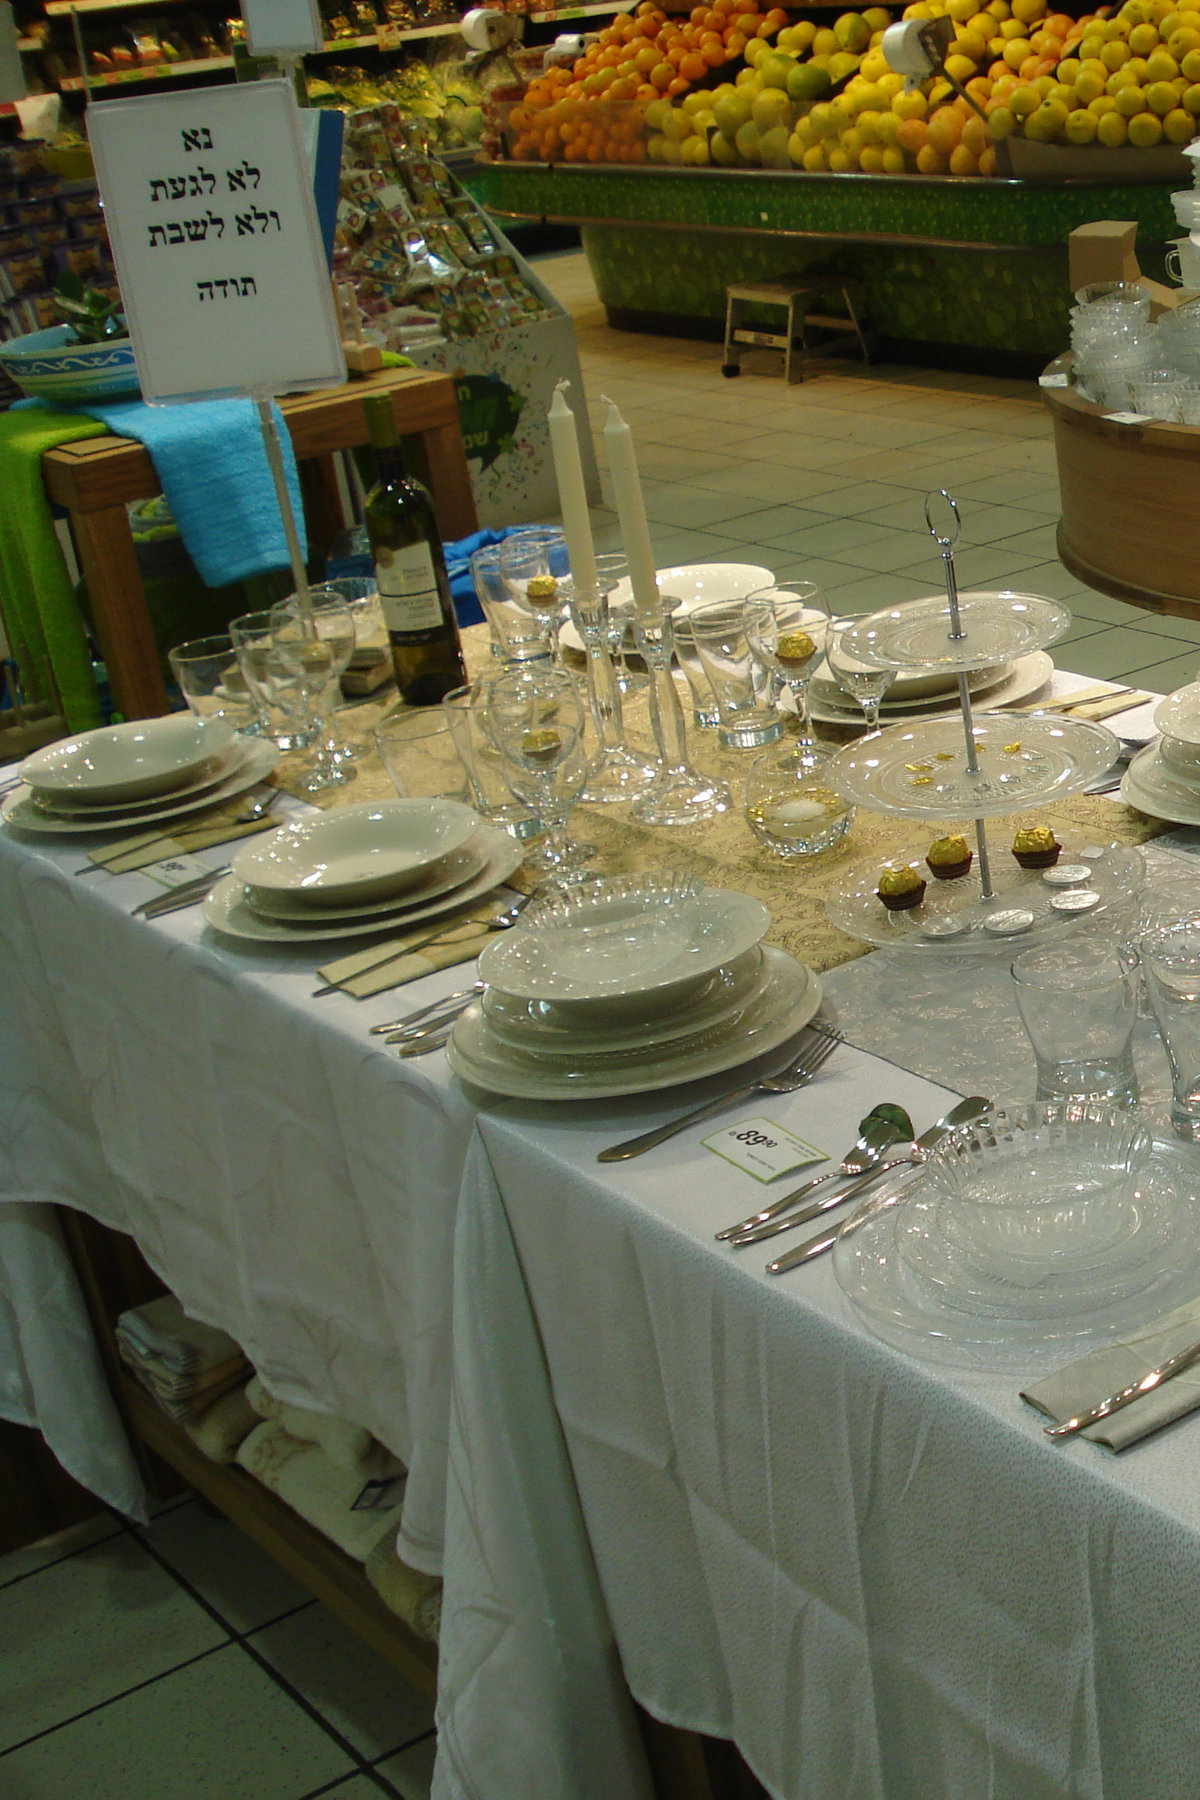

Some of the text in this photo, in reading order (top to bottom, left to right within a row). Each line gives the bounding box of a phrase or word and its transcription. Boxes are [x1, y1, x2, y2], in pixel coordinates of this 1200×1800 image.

[181, 127, 213, 151] נא
[149, 160, 261, 201] לא לגעת
[148, 205, 281, 247] ולא לשבת
[197, 277, 257, 301] תודה
